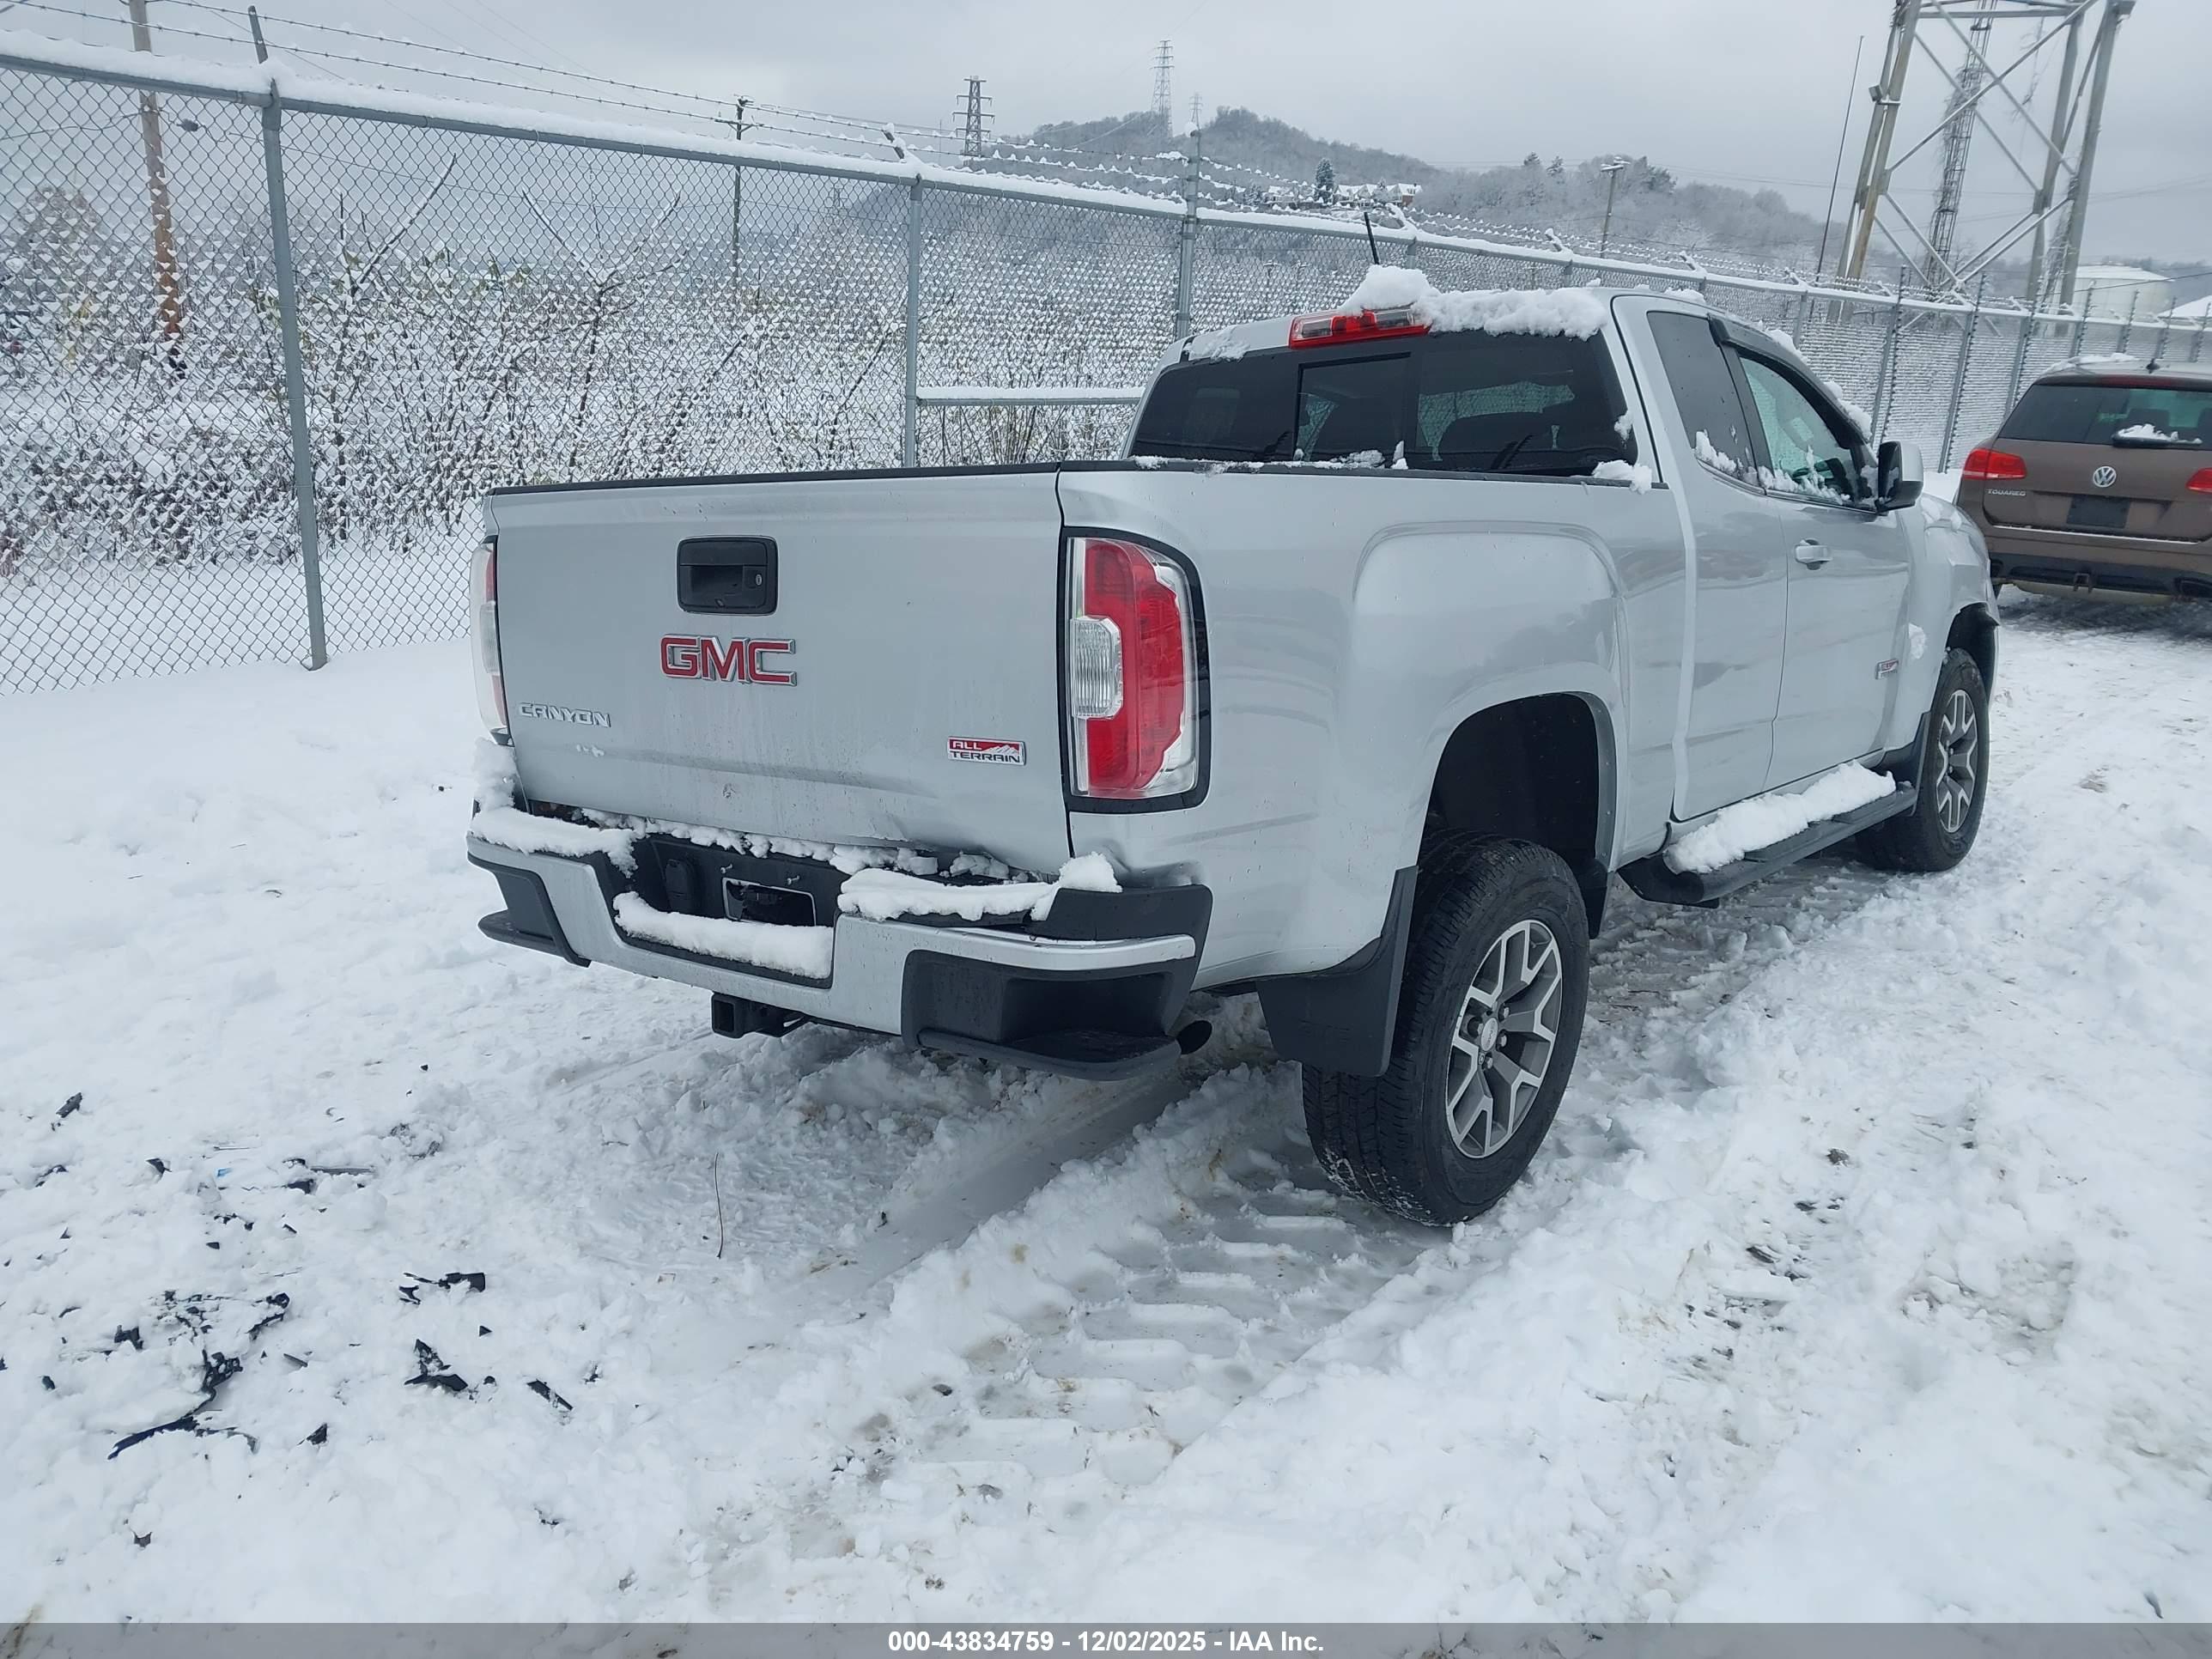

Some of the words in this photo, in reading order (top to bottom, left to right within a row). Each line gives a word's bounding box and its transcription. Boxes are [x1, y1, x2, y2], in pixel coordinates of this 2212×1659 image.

[660, 634, 797, 686] GMC
[519, 702, 611, 728] CANYON
[952, 740, 982, 750] ALL
[950, 750, 1020, 763] TERRAIN
